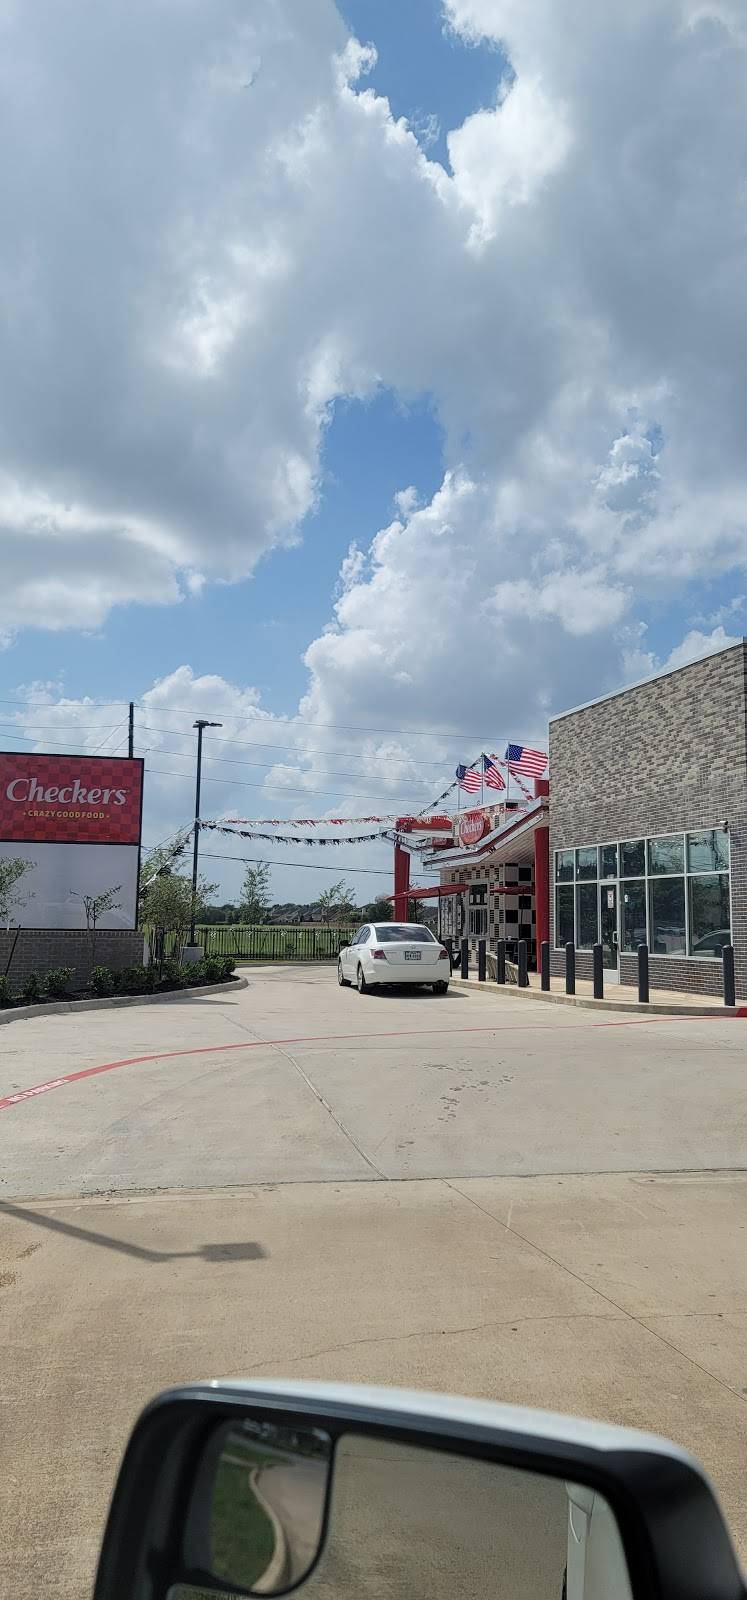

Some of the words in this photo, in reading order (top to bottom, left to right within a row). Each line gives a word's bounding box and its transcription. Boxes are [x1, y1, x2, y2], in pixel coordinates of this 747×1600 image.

[6, 777, 128, 806] Checkers
[27, 809, 56, 818] CRAZY
[56, 810, 81, 819] GOOD
[81, 811, 105, 820] FOOD
